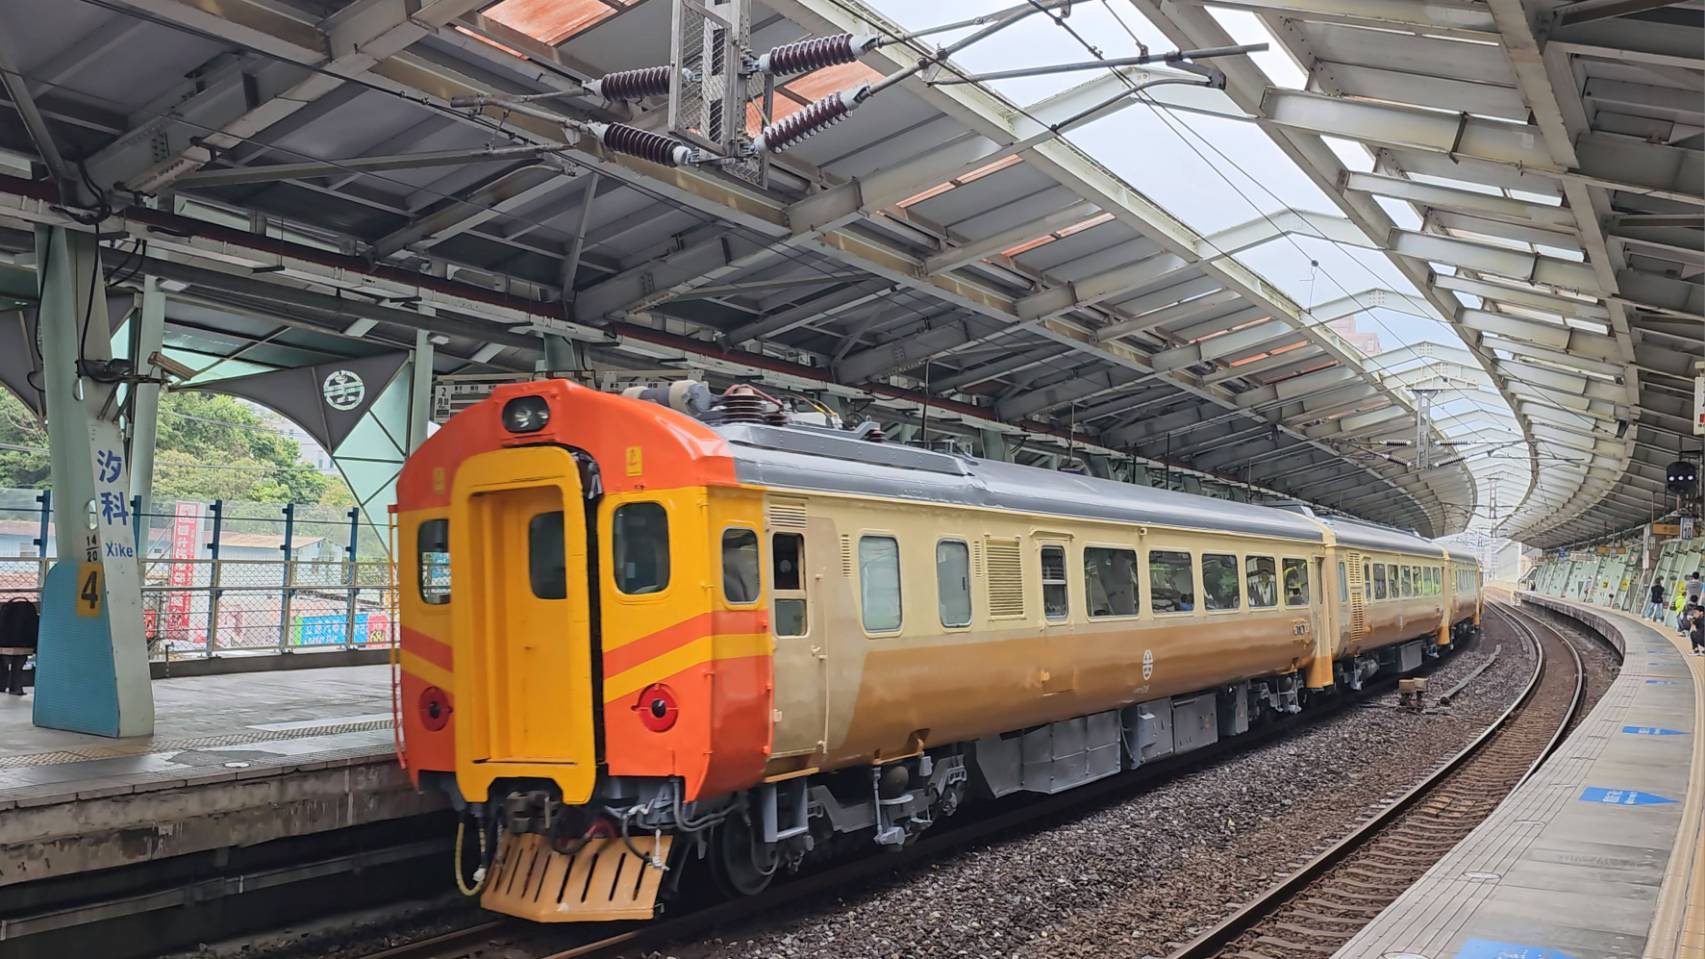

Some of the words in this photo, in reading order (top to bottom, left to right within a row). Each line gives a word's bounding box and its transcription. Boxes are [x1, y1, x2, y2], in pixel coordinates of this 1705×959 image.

[97, 449, 129, 526] 汐科
[86, 535, 97, 546] 14
[86, 550, 98, 562] 20
[105, 541, 134, 558] Xike
[81, 570, 99, 609] 4
